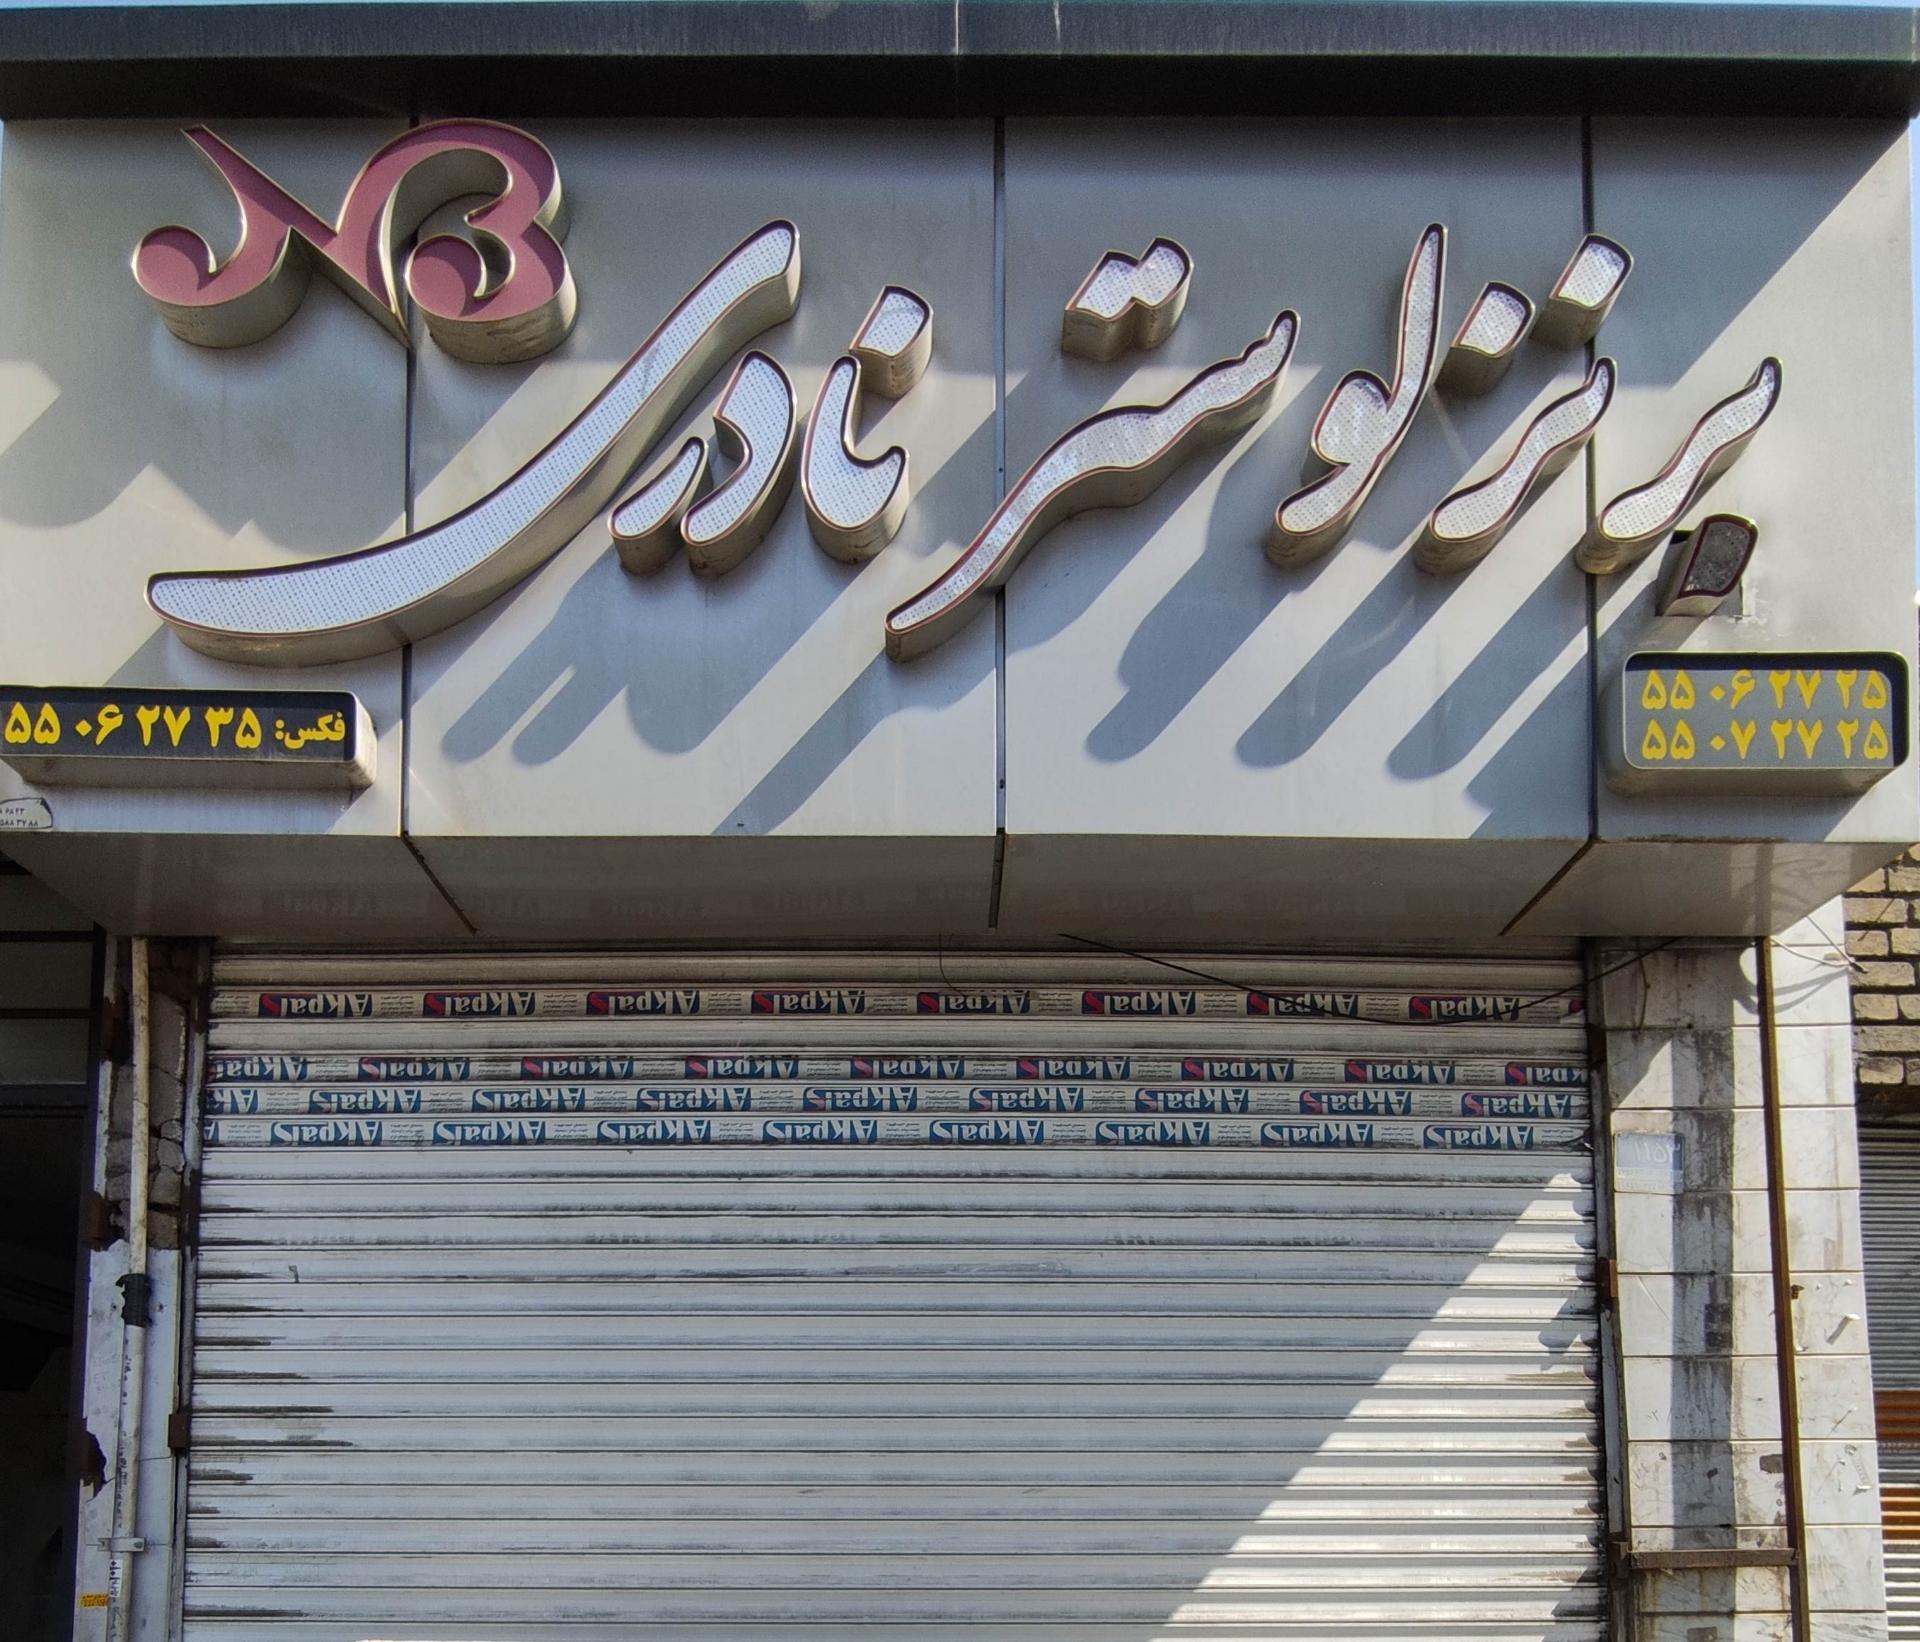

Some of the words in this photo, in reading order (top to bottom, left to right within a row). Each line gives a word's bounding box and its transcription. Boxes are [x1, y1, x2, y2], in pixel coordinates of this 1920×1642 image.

[146, 217, 933, 655] نادری
[1641, 669, 1695, 710] ۵۵
[1710, 669, 1756, 710] ۰۶
[1768, 669, 1822, 710] ۲۷
[1835, 669, 1888, 710] ۲۵
[4, 702, 61, 744] ۵۵
[75, 704, 124, 746] ۰۶
[136, 705, 191, 747] ۲۷
[204, 707, 262, 749] ۳۵
[275, 711, 346, 749] فکس:
[1641, 719, 1695, 760] ۵۵
[1710, 719, 1757, 760] ۰۷
[1770, 719, 1823, 760] ۲۷
[1836, 719, 1889, 760] ۲۵
